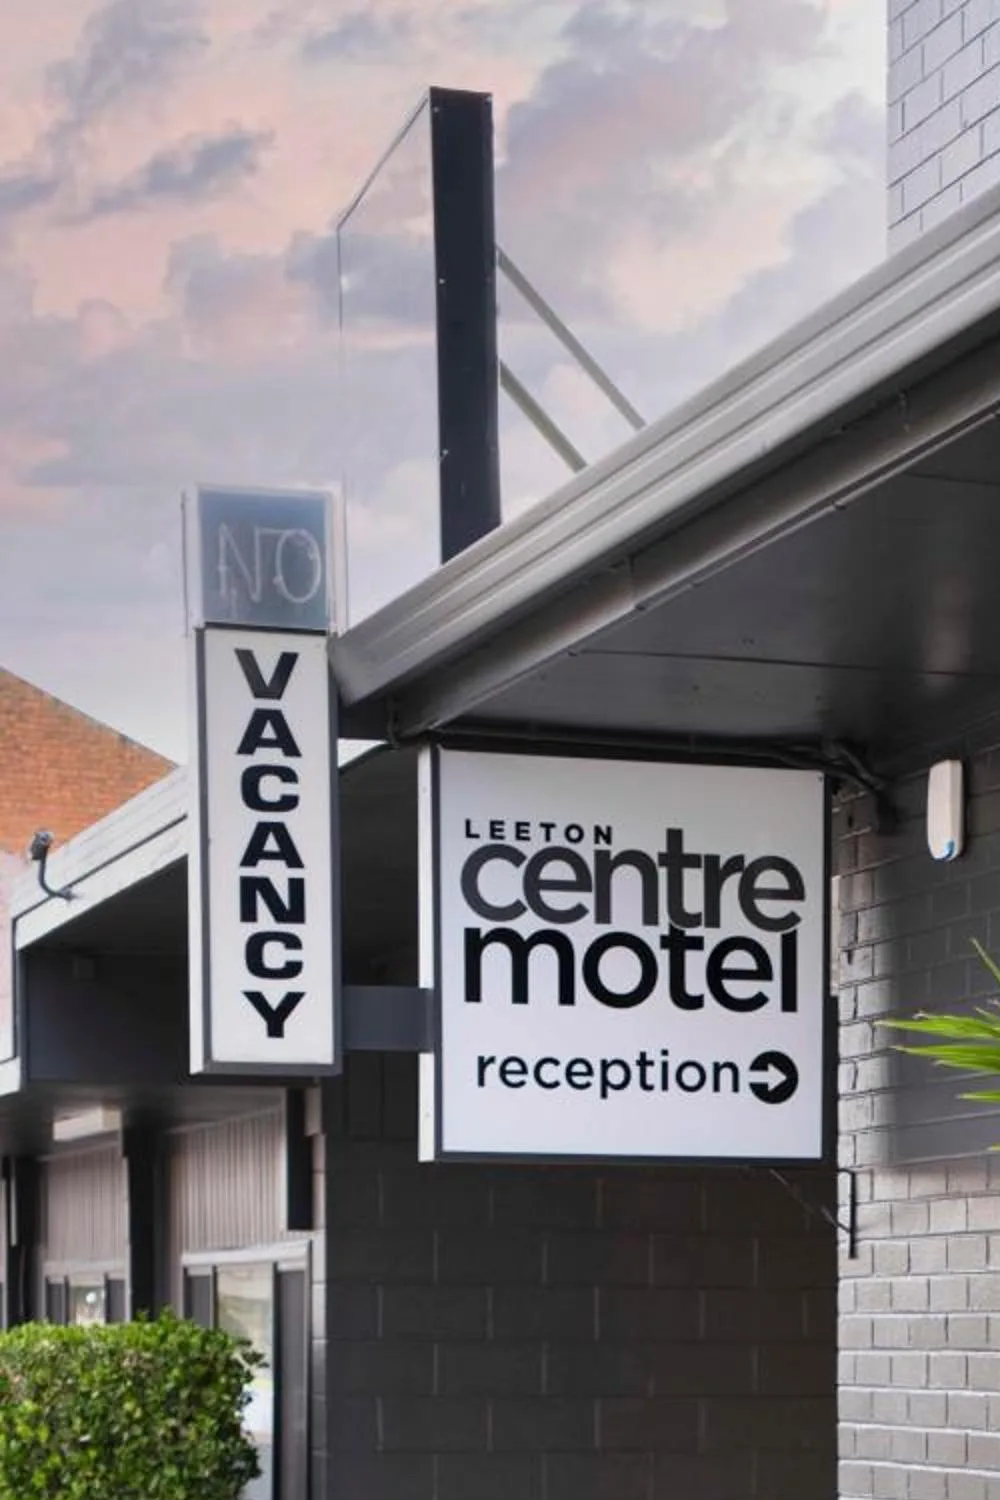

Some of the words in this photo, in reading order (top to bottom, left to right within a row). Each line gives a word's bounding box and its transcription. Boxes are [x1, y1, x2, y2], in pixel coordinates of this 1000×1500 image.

[216, 521, 323, 604] NO
[234, 647, 307, 1039] VACANCY
[464, 818, 614, 846] LEETON
[460, 827, 807, 933] centre
[463, 923, 800, 1013] motel
[476, 1048, 741, 1099] reception
